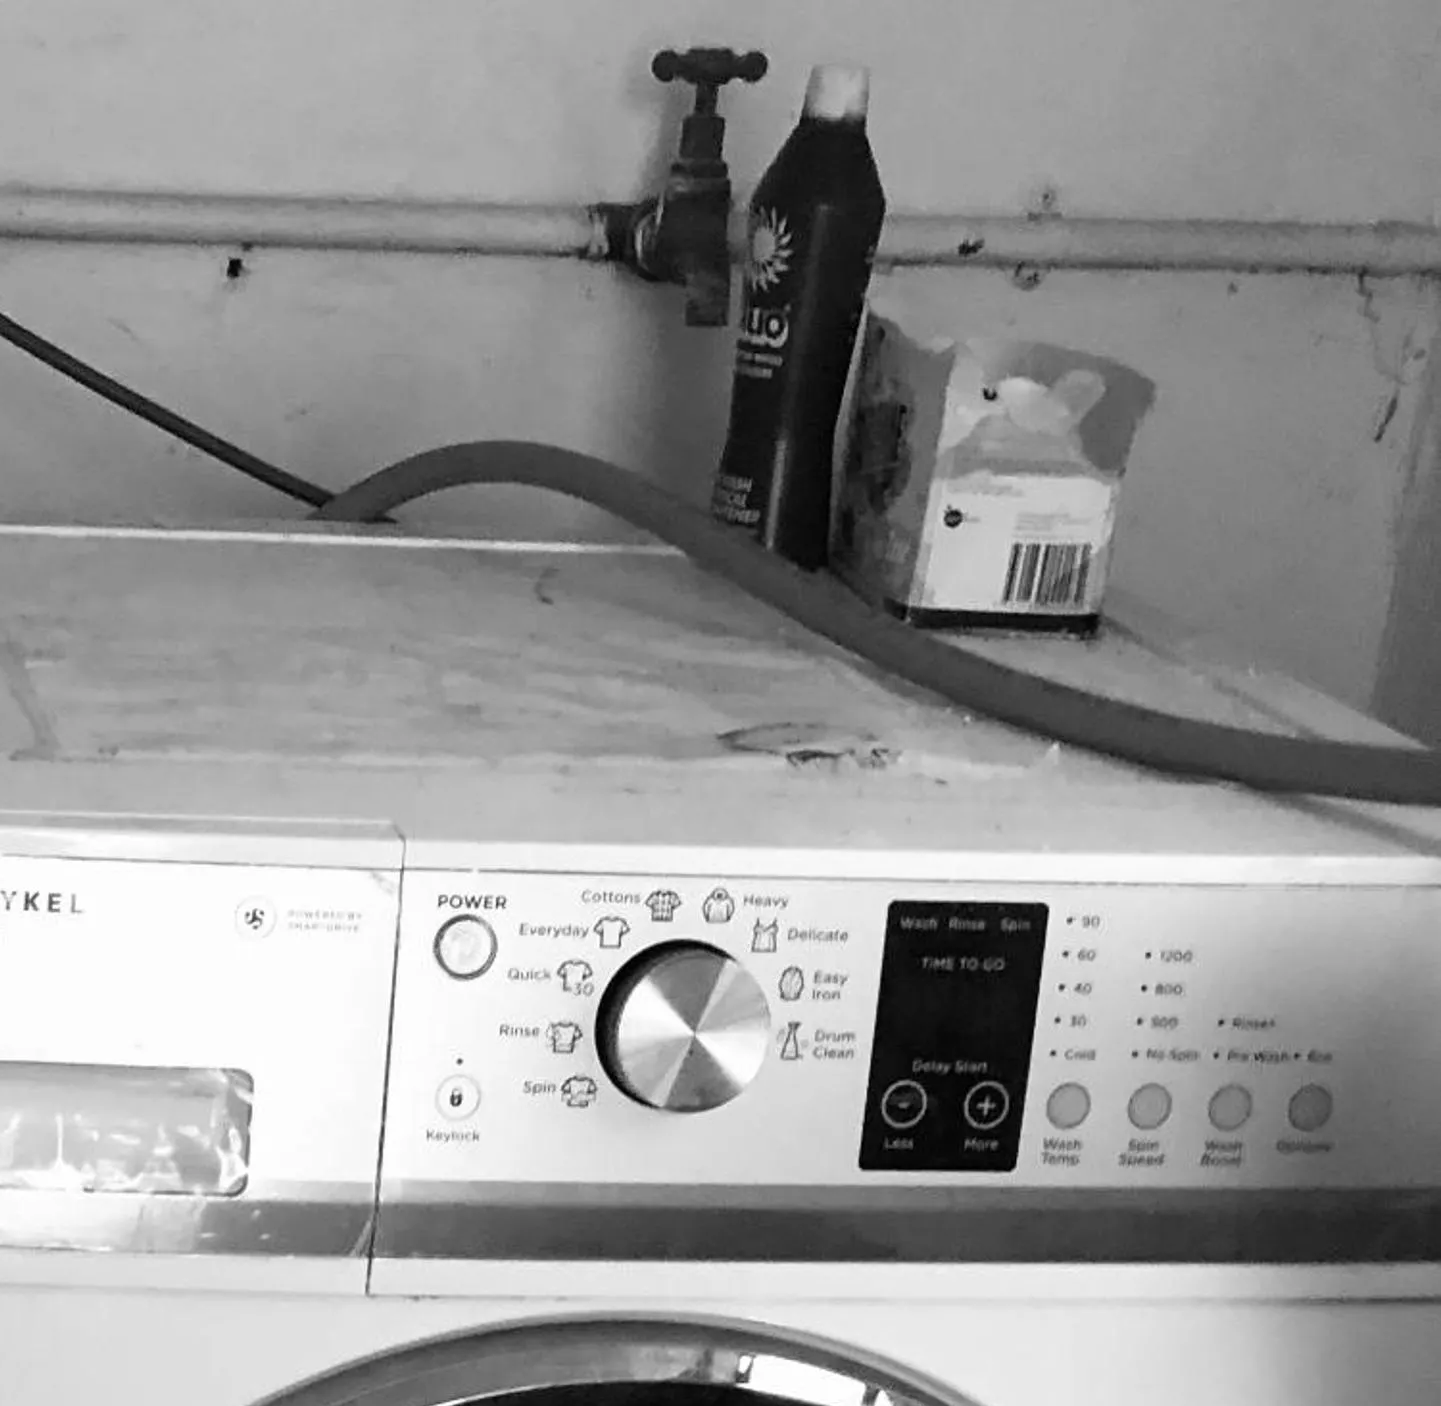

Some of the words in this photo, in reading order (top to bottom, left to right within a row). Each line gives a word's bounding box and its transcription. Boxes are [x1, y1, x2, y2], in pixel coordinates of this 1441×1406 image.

[437, 894, 508, 910] POWER
[581, 889, 642, 904] Cottons
[743, 894, 789, 909] Heavy
[519, 922, 589, 938] Everyday
[788, 926, 849, 942] Delicate
[1077, 949, 1097, 961] 60
[922, 956, 955, 971] TIME
[960, 956, 978, 971] TO
[507, 967, 551, 981] Quick
[813, 970, 848, 986] Easy
[573, 982, 595, 996] 30
[812, 989, 842, 1000] Iron
[499, 1023, 541, 1037] Rinse
[814, 1028, 857, 1043] Drum
[812, 1046, 855, 1060] Clean
[523, 1080, 558, 1096] Spin
[426, 1128, 480, 1143] Keylock
[964, 1137, 999, 1151] More
